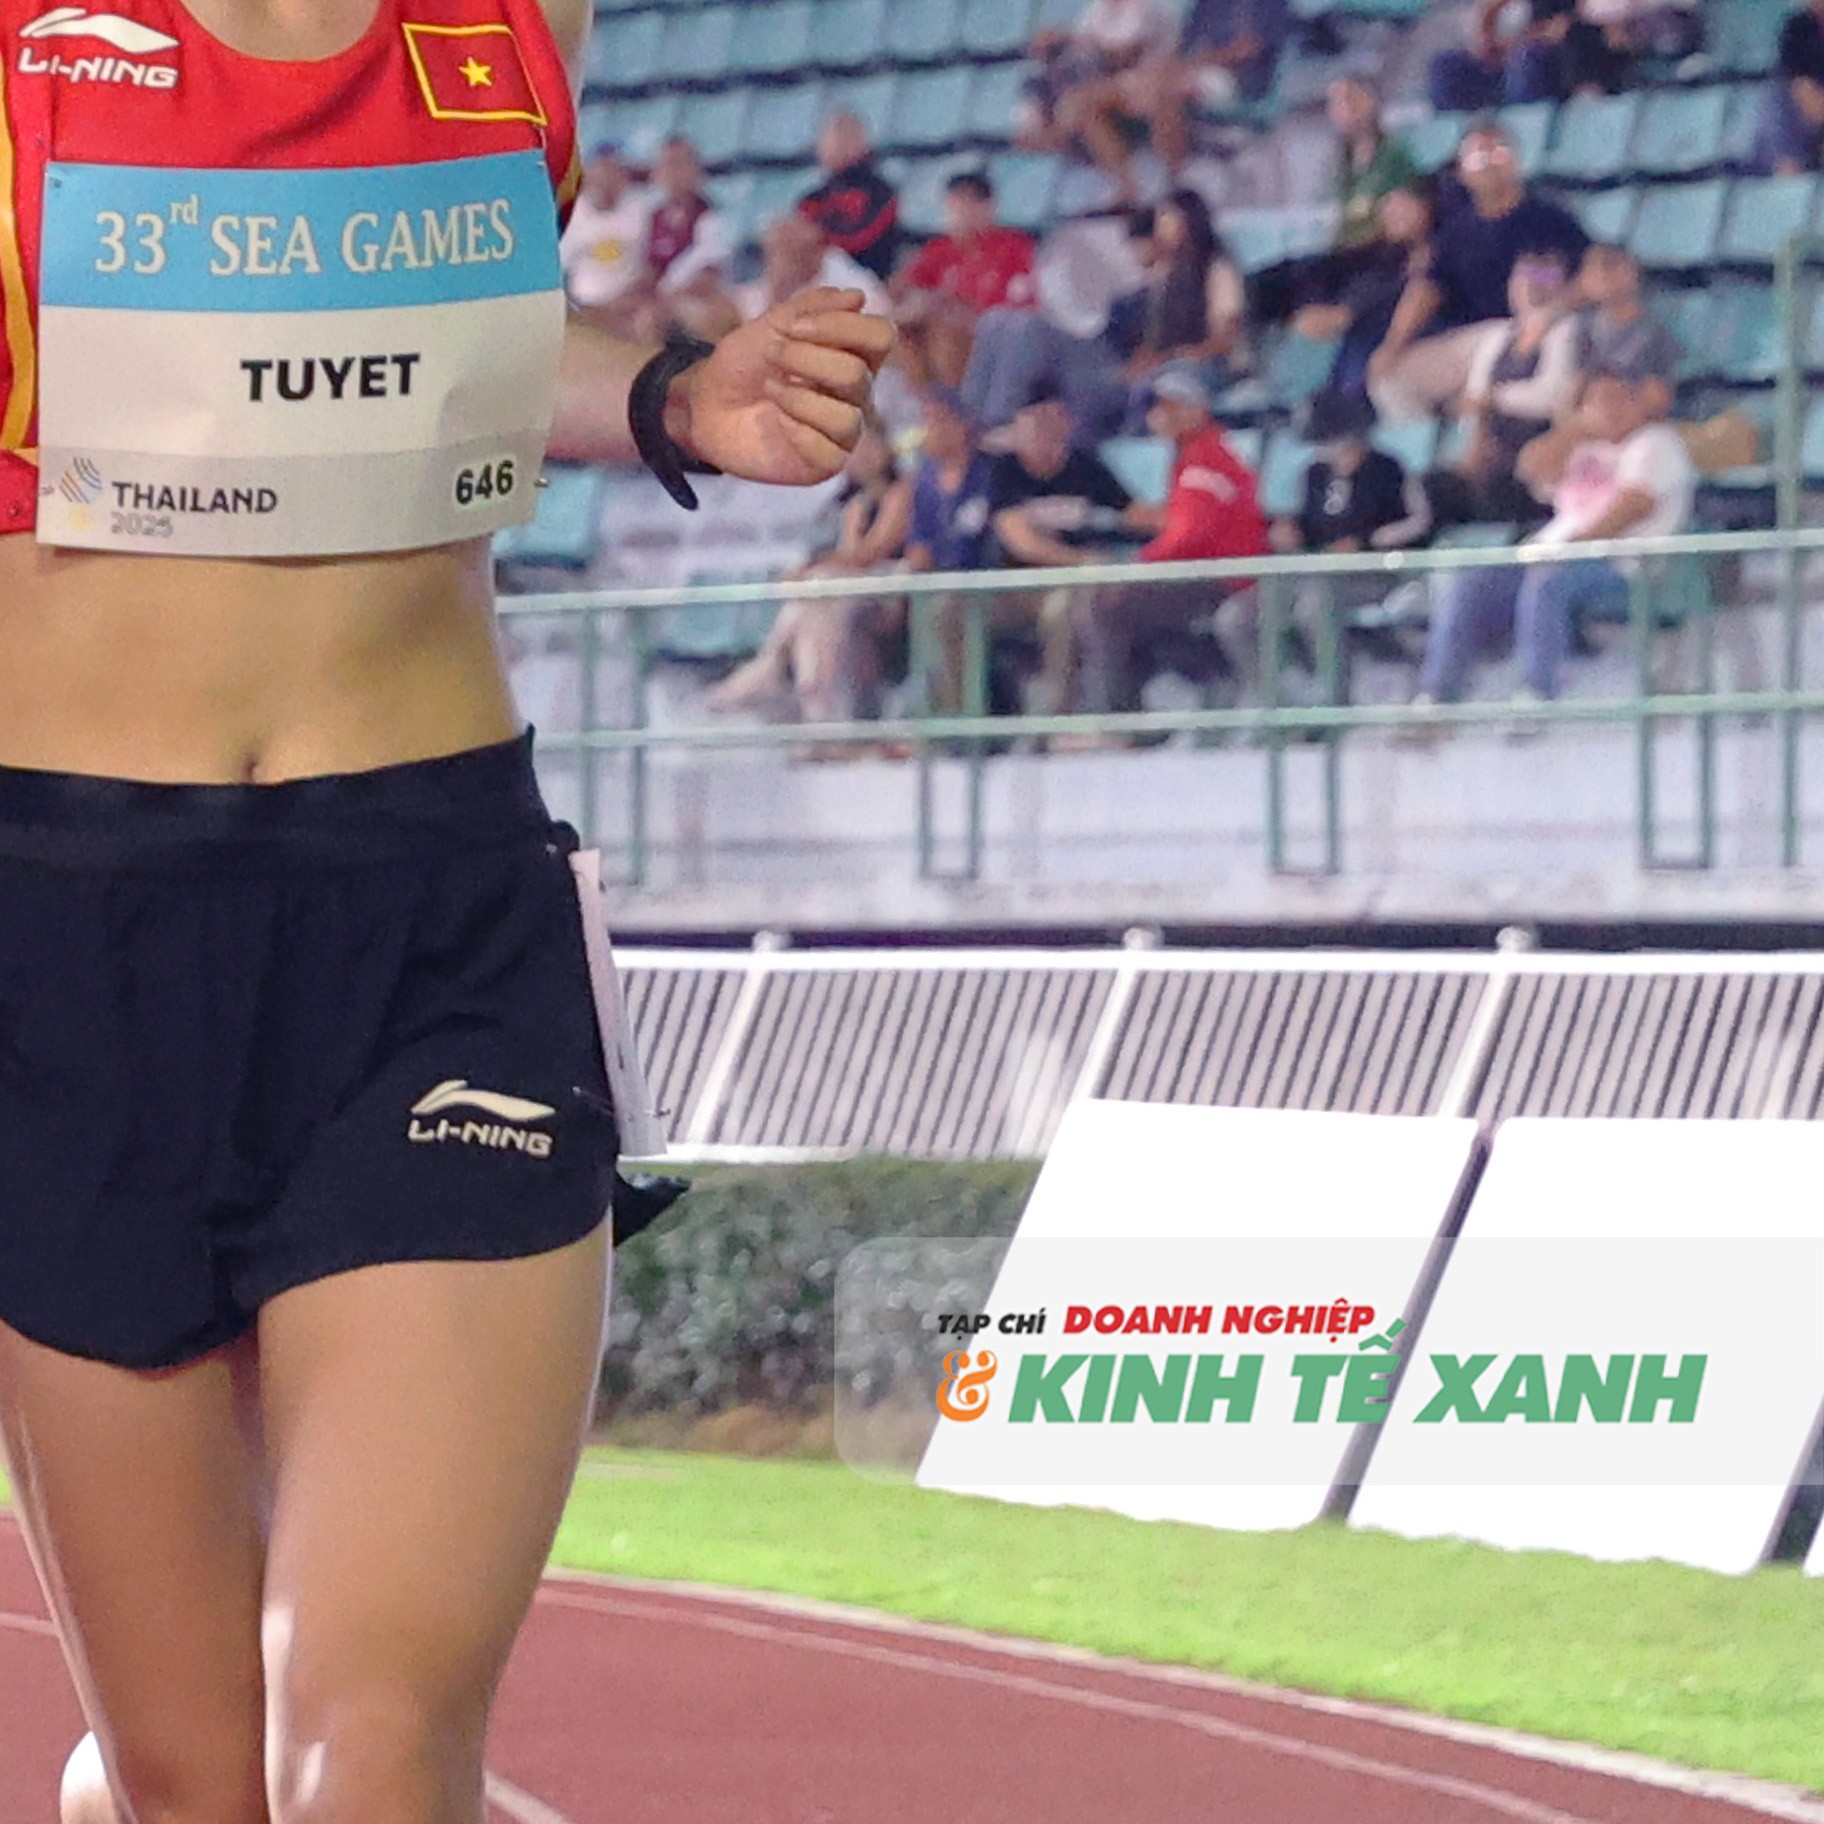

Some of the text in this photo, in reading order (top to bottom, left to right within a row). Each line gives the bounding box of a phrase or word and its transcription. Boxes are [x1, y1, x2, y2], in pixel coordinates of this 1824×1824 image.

[18, 47, 179, 88] LI-NING
[94, 195, 514, 275] 33rd SEA GAMES
[240, 354, 420, 402] TUYET
[111, 481, 277, 514] THAILAND
[456, 462, 514, 504] 646
[110, 511, 173, 538] 2025
[408, 1118, 553, 1158] LI-NING
